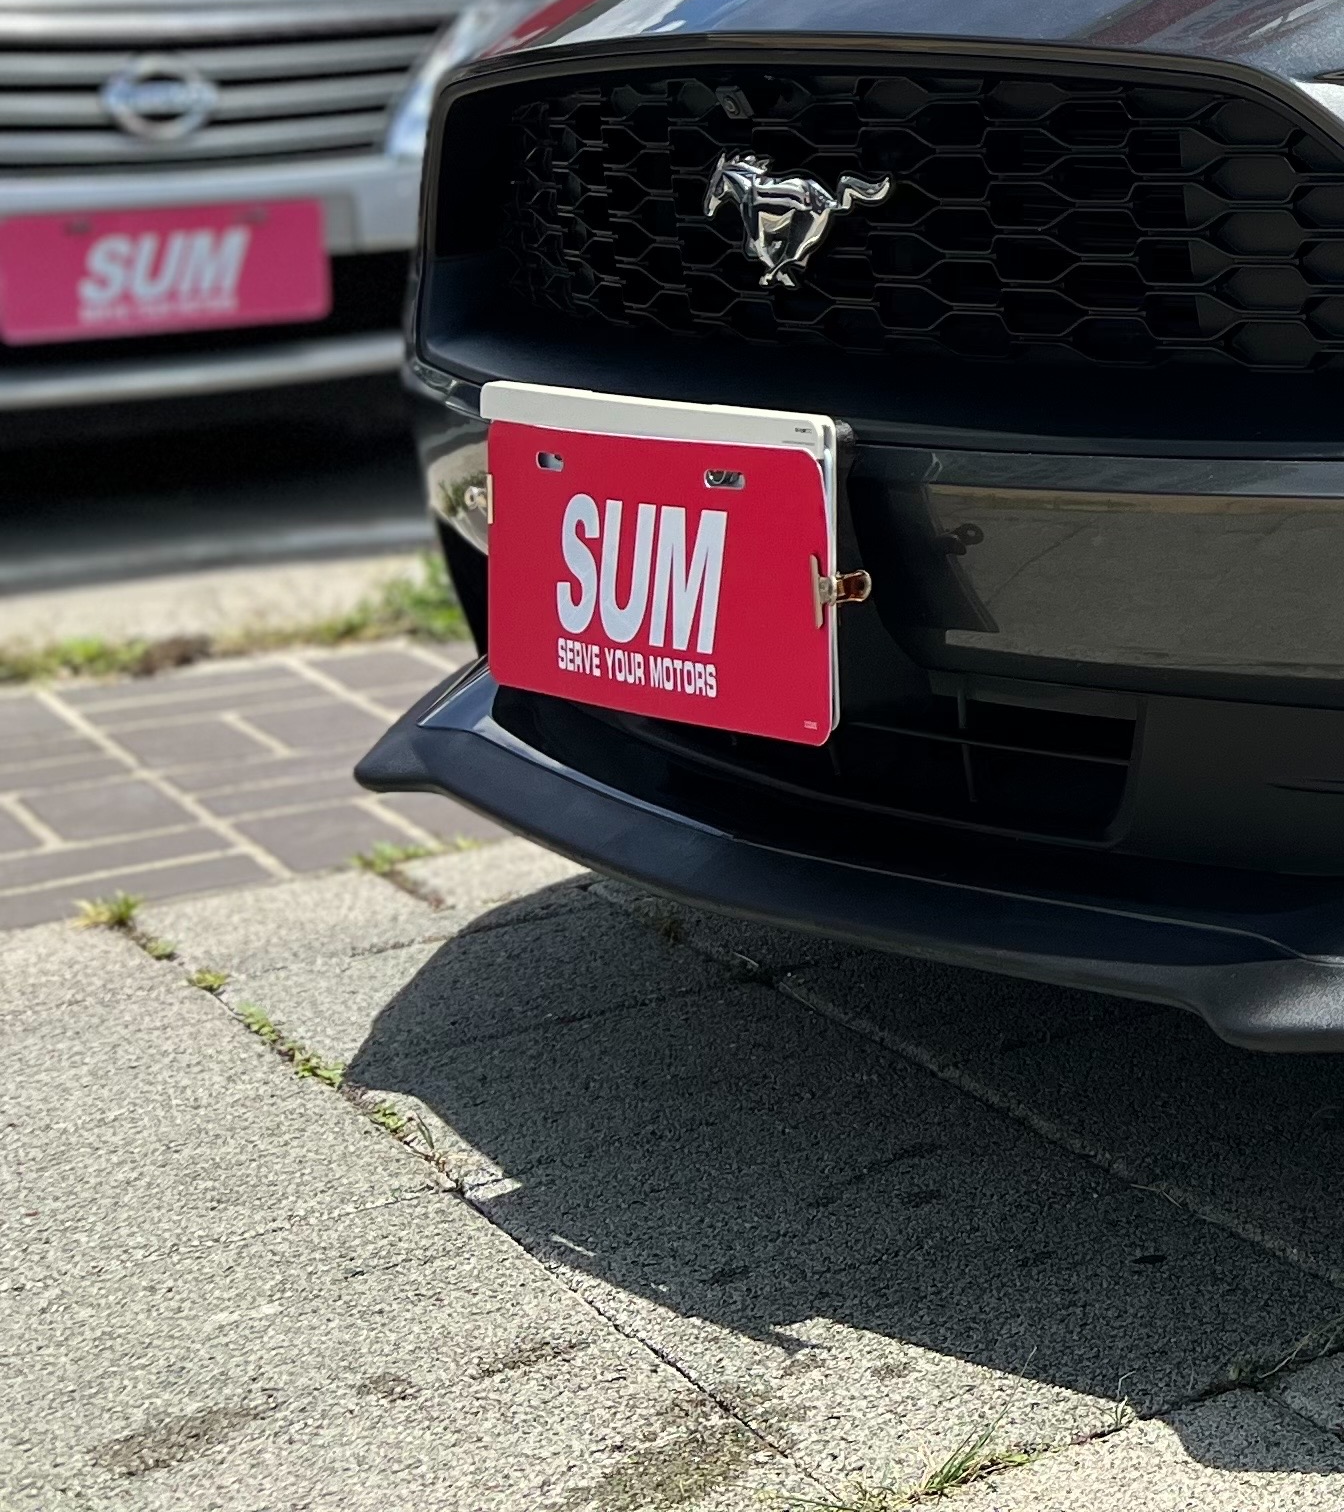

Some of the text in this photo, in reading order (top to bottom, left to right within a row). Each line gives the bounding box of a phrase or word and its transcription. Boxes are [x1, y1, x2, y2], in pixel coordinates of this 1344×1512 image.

[78, 226, 251, 305] SUM
[556, 492, 729, 655] SUM
[557, 637, 718, 699] SERVE YOUR MOTORS
